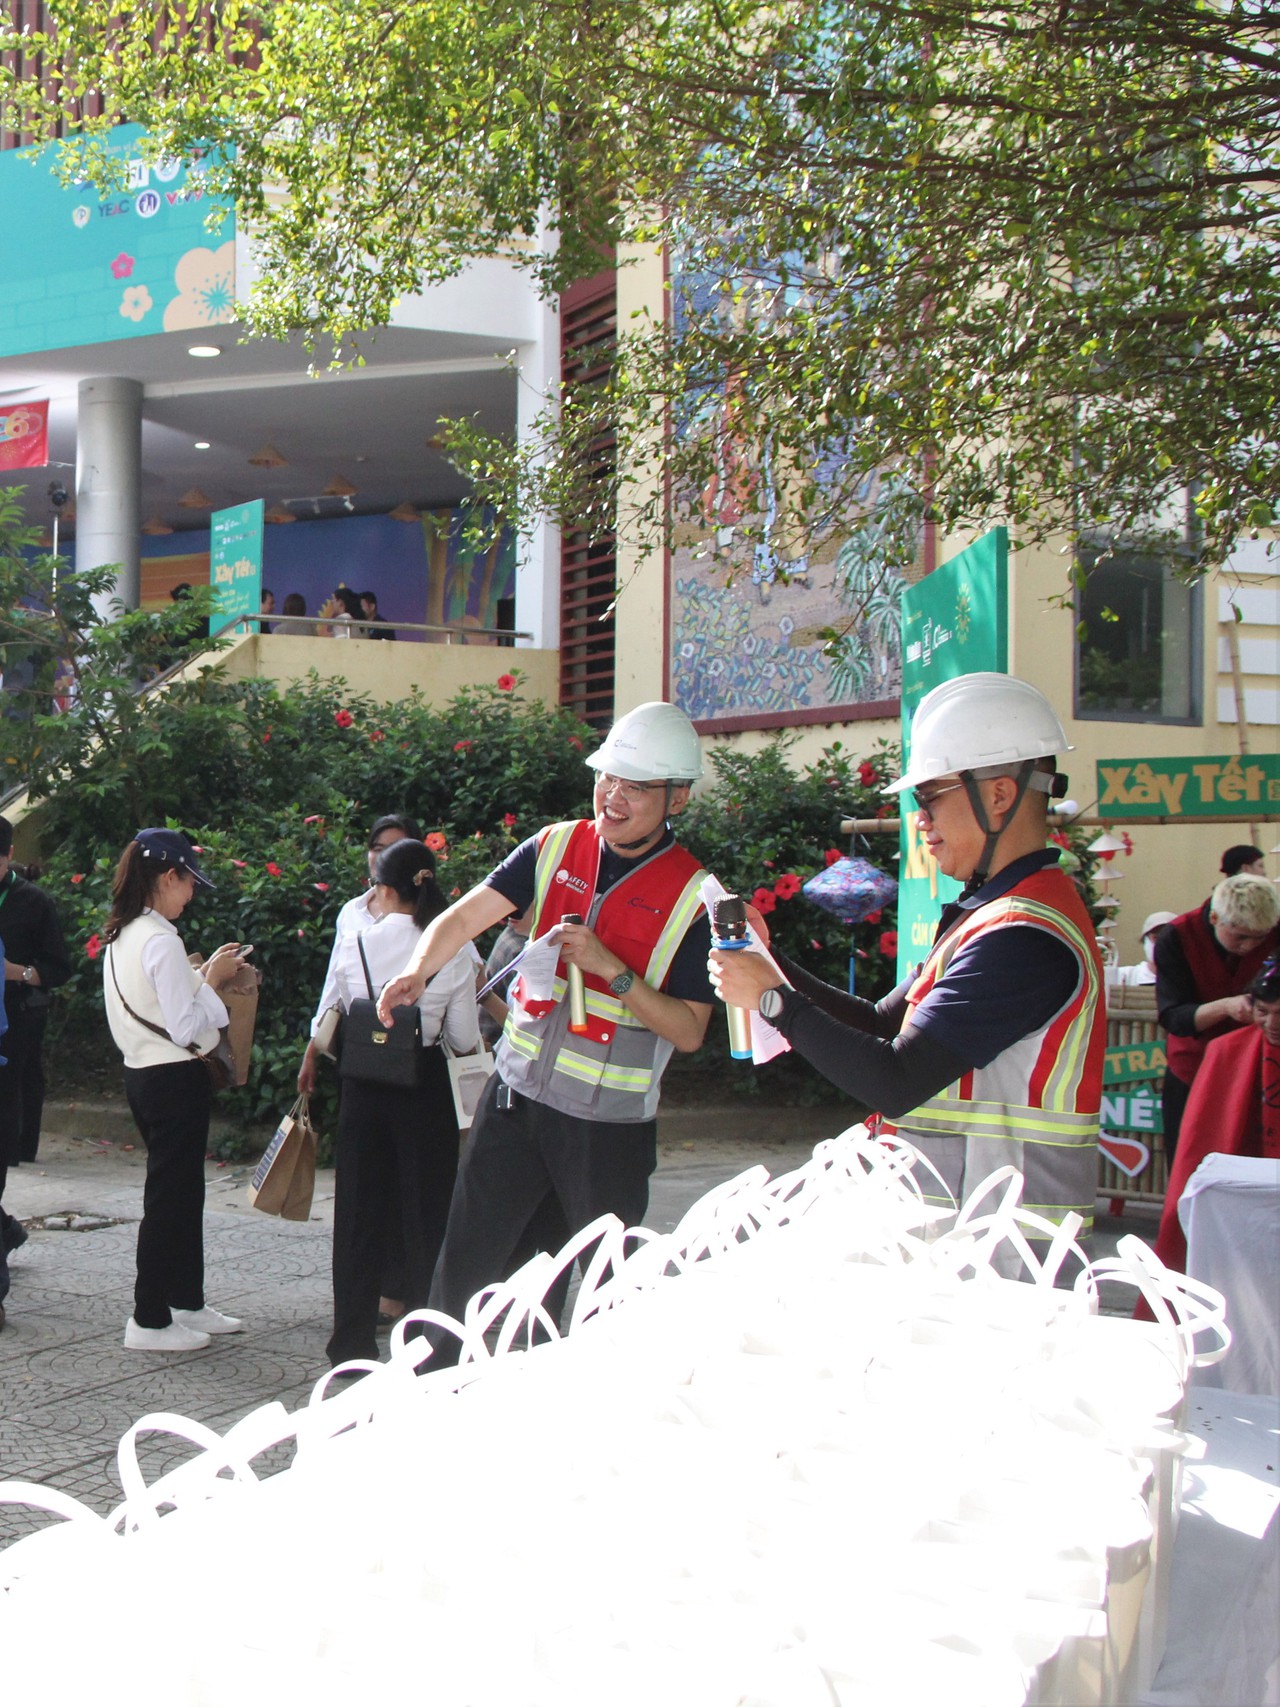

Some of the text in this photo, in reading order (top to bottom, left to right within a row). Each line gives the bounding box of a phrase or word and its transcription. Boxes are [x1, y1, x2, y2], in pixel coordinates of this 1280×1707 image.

[1099, 762, 1189, 815] Xây
[1192, 755, 1266, 802] Tết
[1099, 1089, 1164, 1129] NÉ
